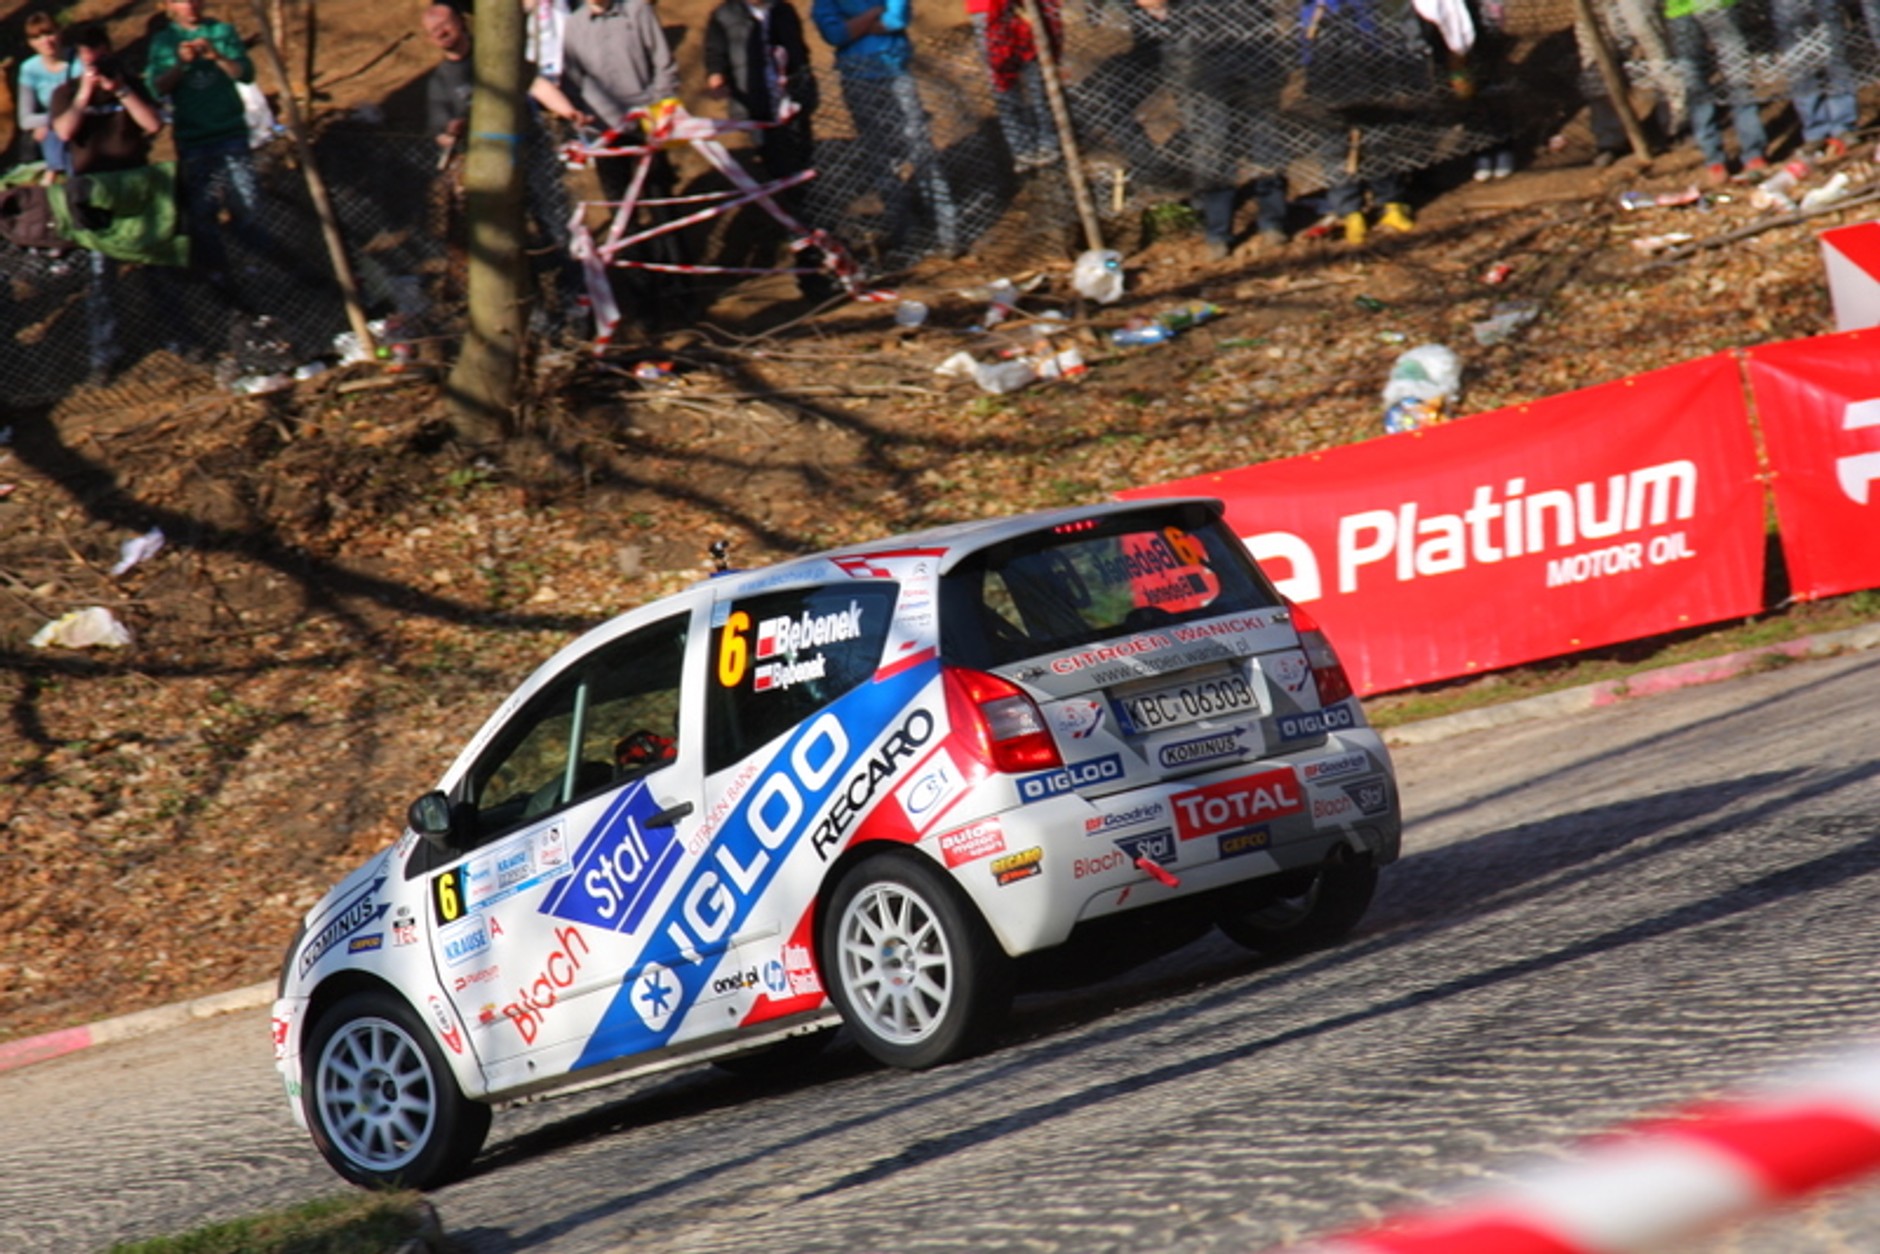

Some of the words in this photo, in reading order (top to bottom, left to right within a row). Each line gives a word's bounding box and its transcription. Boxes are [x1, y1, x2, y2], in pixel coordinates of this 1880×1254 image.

[1338, 460, 1697, 593] Platinum
[1546, 543, 1642, 587] MOTOR
[1649, 532, 1695, 565] OIL
[718, 611, 750, 687] 6
[775, 600, 863, 658] Bębenek
[1171, 616, 1264, 643] WANICKI
[1125, 692, 1176, 729] KBC
[1180, 677, 1250, 716] 06303
[1299, 709, 1350, 732] IGLOO
[1165, 737, 1236, 763] KOMINUS
[810, 708, 933, 861] RECARO
[1048, 760, 1119, 793] IGLOO
[1177, 783, 1299, 829] TOTAL
[668, 713, 849, 965] IGLOO
[1137, 834, 1168, 859] Stal
[585, 815, 650, 918] Stal
[439, 873, 458, 920] 6
[303, 897, 376, 966] KOMINUS
[443, 929, 488, 959] KRAUSE
